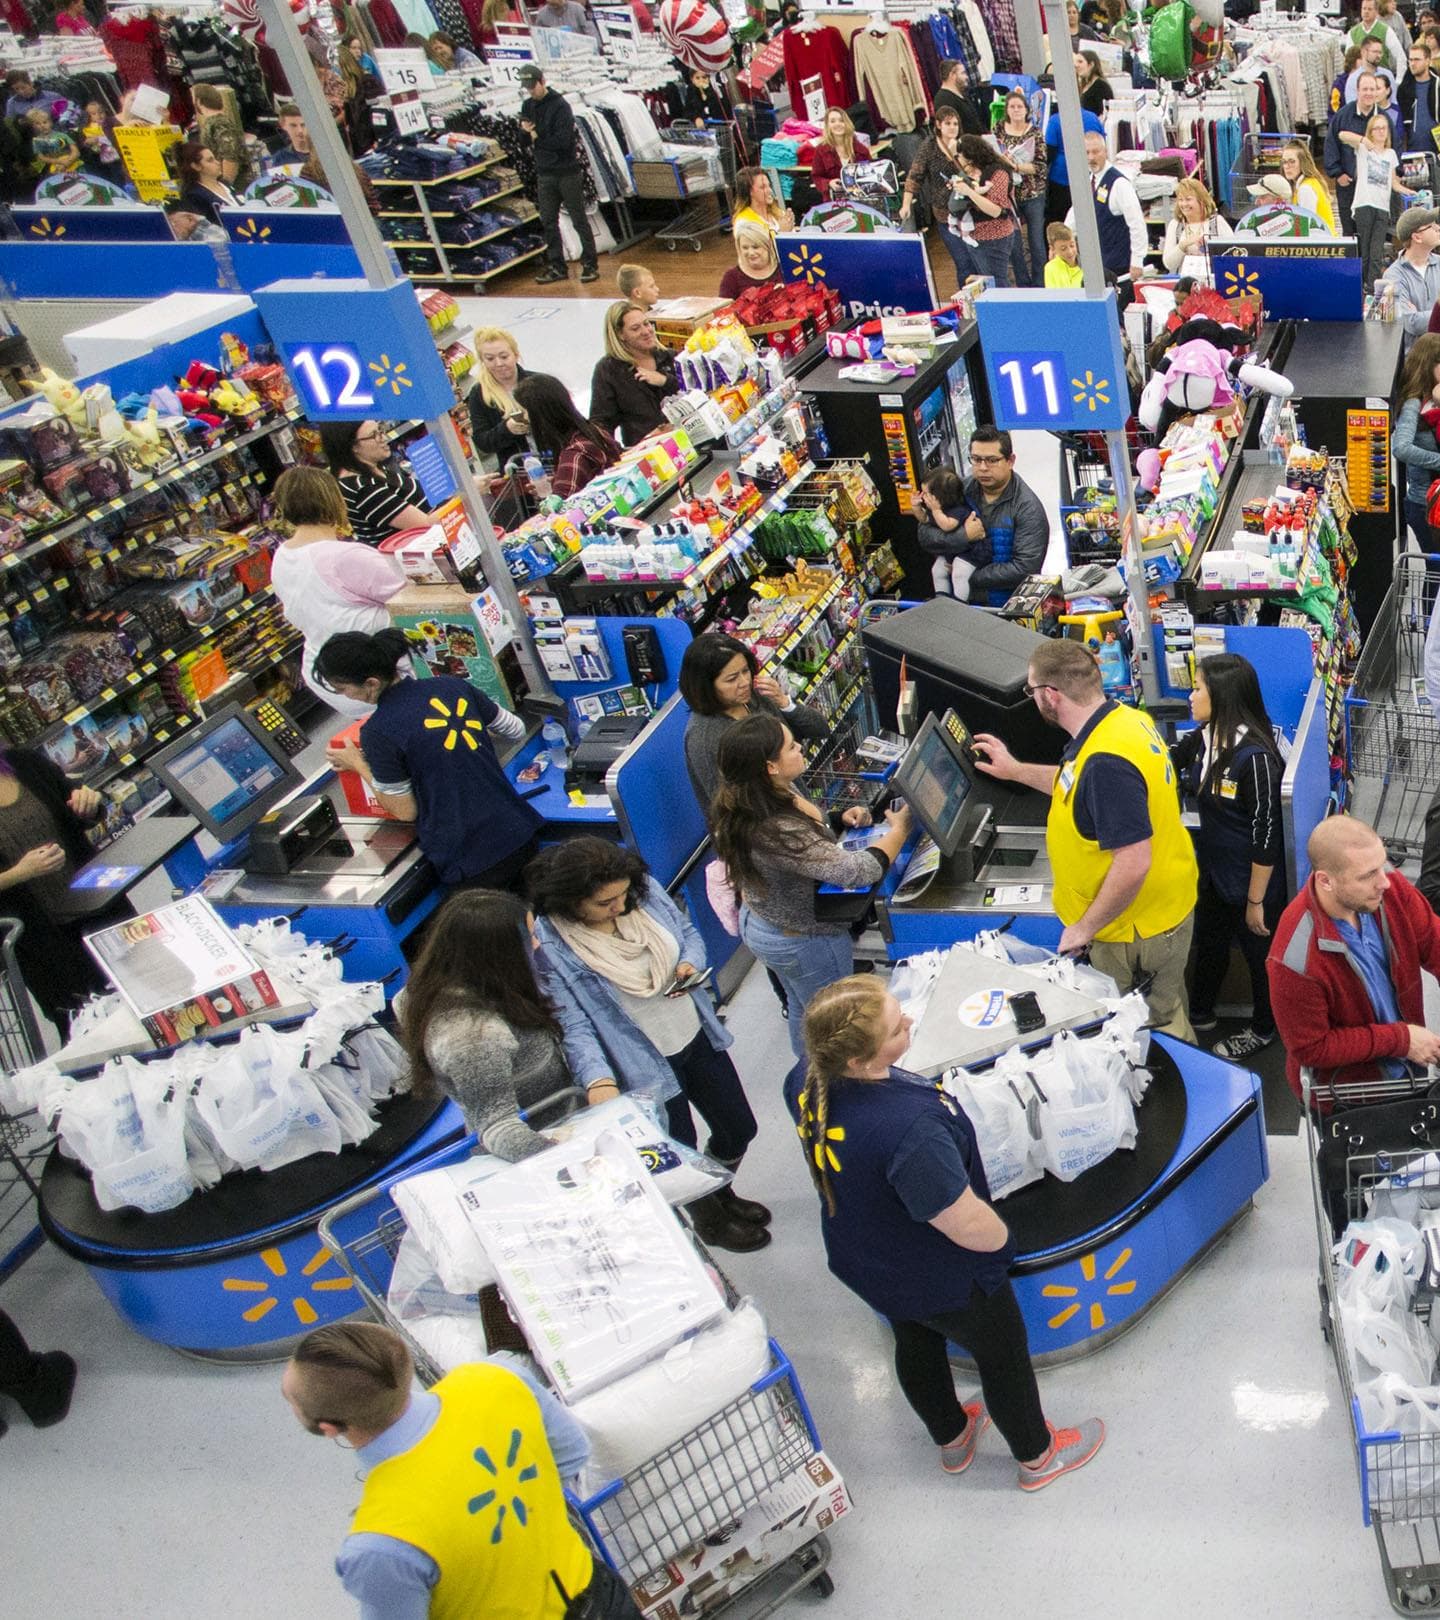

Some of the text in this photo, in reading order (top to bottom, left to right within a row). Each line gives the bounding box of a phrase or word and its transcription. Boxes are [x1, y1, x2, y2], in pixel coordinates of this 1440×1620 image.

[1264, 247, 1346, 257] BENTONVILLE
[849, 300, 907, 319] Price
[293, 350, 375, 407] 12
[999, 360, 1061, 416] 11
[807, 1459, 822, 1477] 18
[829, 1484, 850, 1519] T-fal
